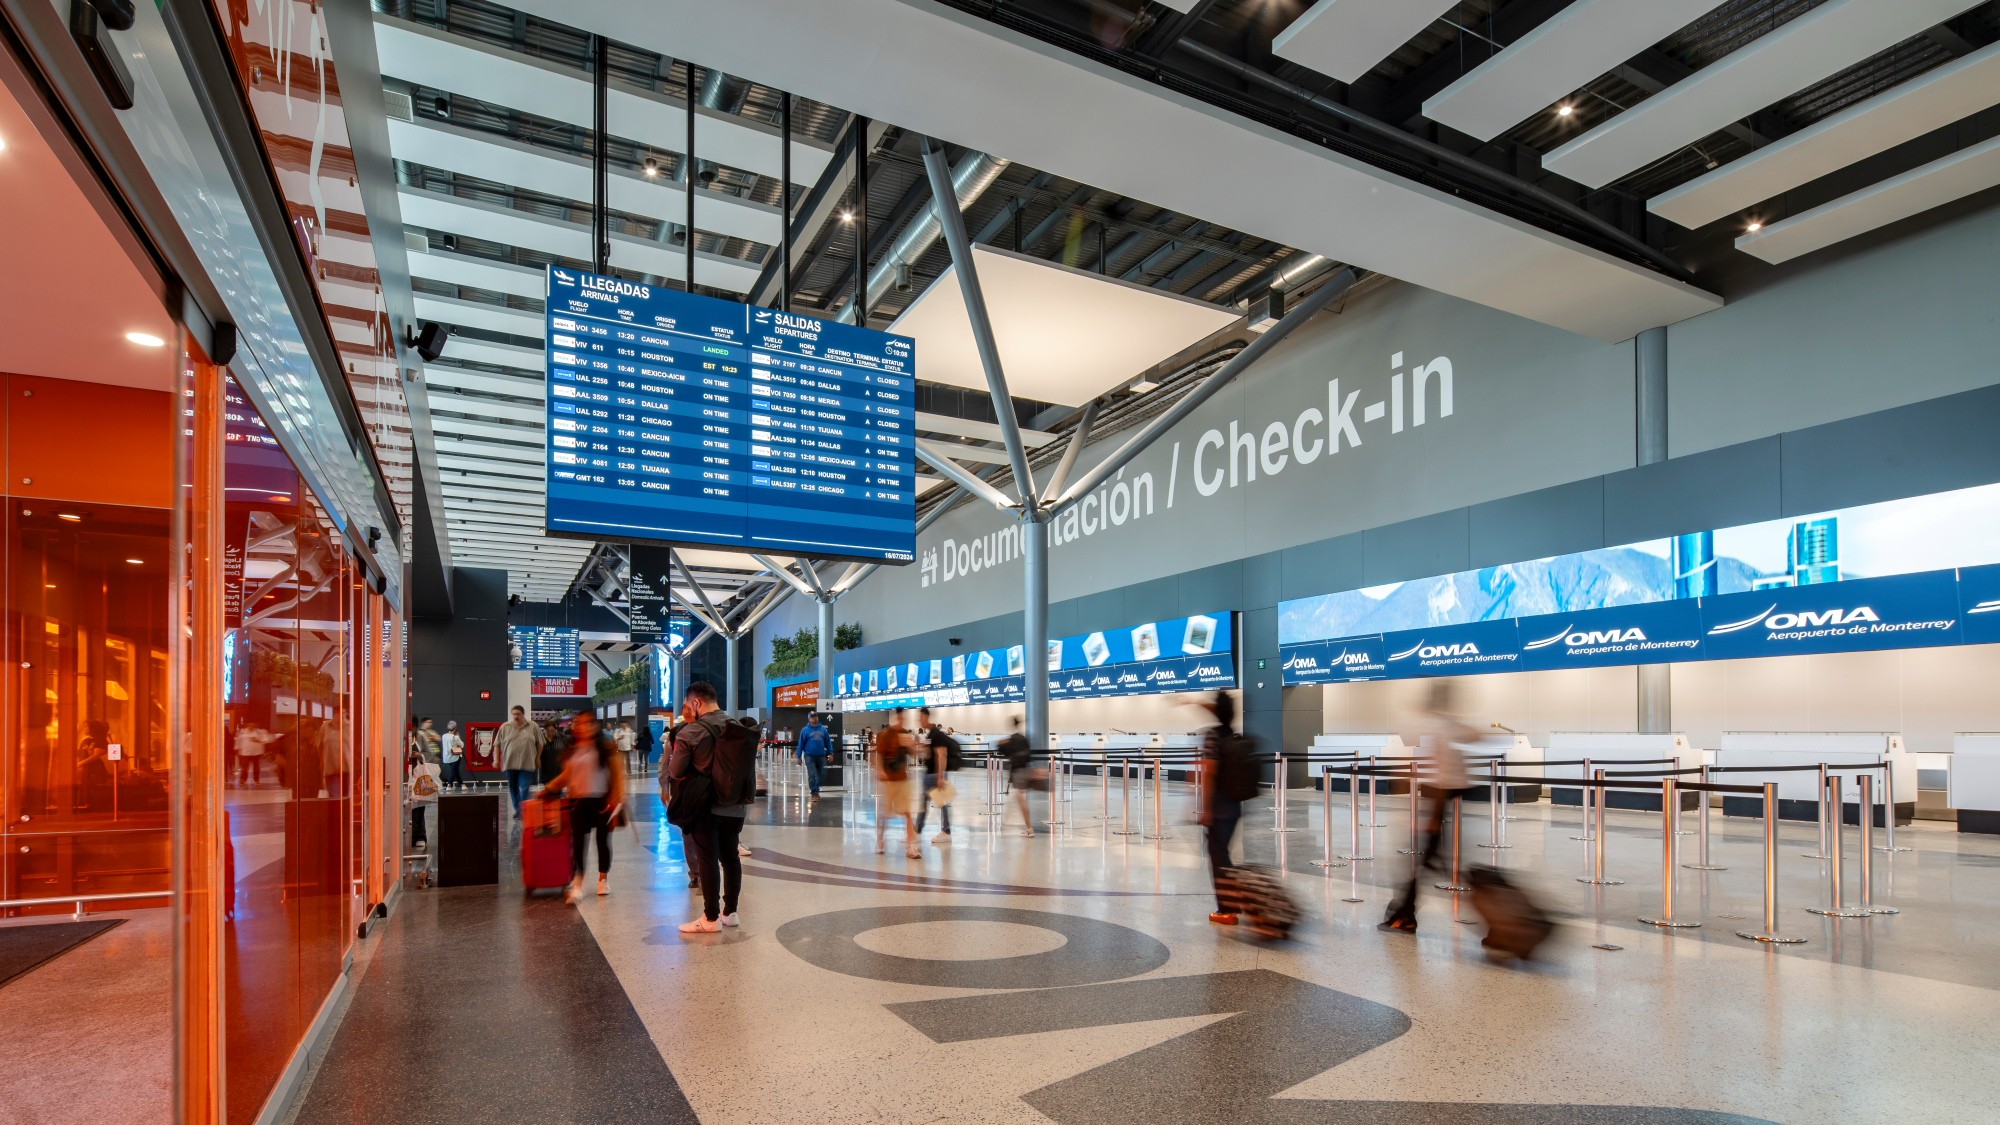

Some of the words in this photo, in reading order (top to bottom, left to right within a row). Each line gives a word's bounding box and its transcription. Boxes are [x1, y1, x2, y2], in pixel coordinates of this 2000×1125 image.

[580, 290, 619, 303] ARRIVALS
[581, 275, 649, 299] LLEGADAS
[569, 300, 588, 308] VUELO
[618, 309, 634, 317] HORA
[655, 316, 676, 324] ORIGEN
[711, 326, 734, 335] ESTATUS
[775, 313, 821, 332] SALIDAS
[576, 323, 588, 332] VOI
[617, 331, 635, 340] 13:20
[641, 336, 669, 346] CANCUN
[703, 346, 729, 356] LANDED
[775, 326, 818, 341] DEPARTURES
[576, 340, 588, 349] VIV
[592, 343, 604, 351] 611
[617, 348, 635, 357] 10:15
[641, 351, 674, 363] HOUSTON
[703, 362, 716, 370] EST
[763, 336, 782, 344] VUELO
[827, 348, 850, 357] DESTINO
[853, 352, 880, 363] TERMINAL
[894, 340, 910, 349] OMA
[576, 358, 588, 366] VIV
[617, 364, 635, 373] 10:40
[641, 368, 686, 381] MEXICO-AICM
[703, 378, 713, 386] ON
[714, 379, 729, 388] TIME
[771, 358, 781, 366] VIV
[817, 367, 842, 377] CANCUN
[877, 376, 900, 386] CLOSED
[576, 374, 591, 382] UAL
[617, 380, 635, 389] 10:48
[641, 384, 674, 395] HOUSTON
[703, 393, 713, 401] ON
[714, 394, 729, 403] TIME
[817, 381, 841, 391] DALLAS
[877, 391, 900, 400] CLOSED
[576, 391, 591, 399] AAL
[641, 400, 669, 411] DALLAS
[714, 410, 729, 419] TIME
[771, 389, 781, 397] VOI
[817, 397, 841, 406] MERIDA
[877, 406, 900, 416] CLOSED
[576, 407, 590, 415] UAL
[641, 416, 673, 427] CHICAGO
[703, 424, 713, 432] ON
[714, 426, 729, 434] TIME
[817, 411, 846, 421] HOUSTON
[877, 420, 900, 429] CLOSED
[576, 423, 588, 431] VIV
[617, 429, 635, 437] 11:40
[641, 432, 670, 442] CANCUN
[714, 441, 730, 449] TIME
[771, 419, 781, 427] VIV
[817, 426, 843, 436] TIJUANA
[877, 434, 886, 442] ON
[887, 435, 900, 444] TIME
[576, 440, 588, 448] VIV
[641, 449, 670, 459] CANCUN
[714, 457, 729, 465] TIME
[818, 441, 841, 450] DALLAS
[576, 457, 588, 465] VIV
[641, 464, 670, 474] TIJUANA
[703, 471, 713, 479] ON
[714, 472, 730, 481] TIME
[771, 449, 781, 457] VIV
[887, 464, 900, 472] TIME
[943, 467, 1154, 582] Documtación
[1167, 442, 1179, 508] /
[1193, 350, 1454, 496] Check-in
[576, 474, 591, 482] GMT
[641, 481, 670, 490] CANCUN
[703, 487, 713, 495] ON
[714, 488, 729, 496] TIME
[818, 471, 846, 480] HOUSTON
[817, 485, 845, 494] CHICAGO
[887, 493, 900, 501] TIME
[1765, 606, 1880, 629] OMA
[1565, 628, 1646, 646] OMA
[1767, 628, 1846, 640] Aeropuerto
[1849, 625, 1867, 634] de
[1870, 620, 1955, 633] Monterrey
[1419, 643, 1479, 658] OMA
[1567, 645, 1623, 655] Aeropuerto
[1625, 643, 1638, 651] de
[1640, 640, 1699, 650] Monterrey
[1294, 658, 1317, 668] OMA
[1344, 653, 1369, 664] OMA
[1420, 658, 1462, 666] Aeropuerto
[1475, 654, 1518, 662] Monterrey
[1124, 674, 1138, 682] OMA
[1156, 671, 1175, 680] OMA
[1199, 666, 1220, 676] OMA
